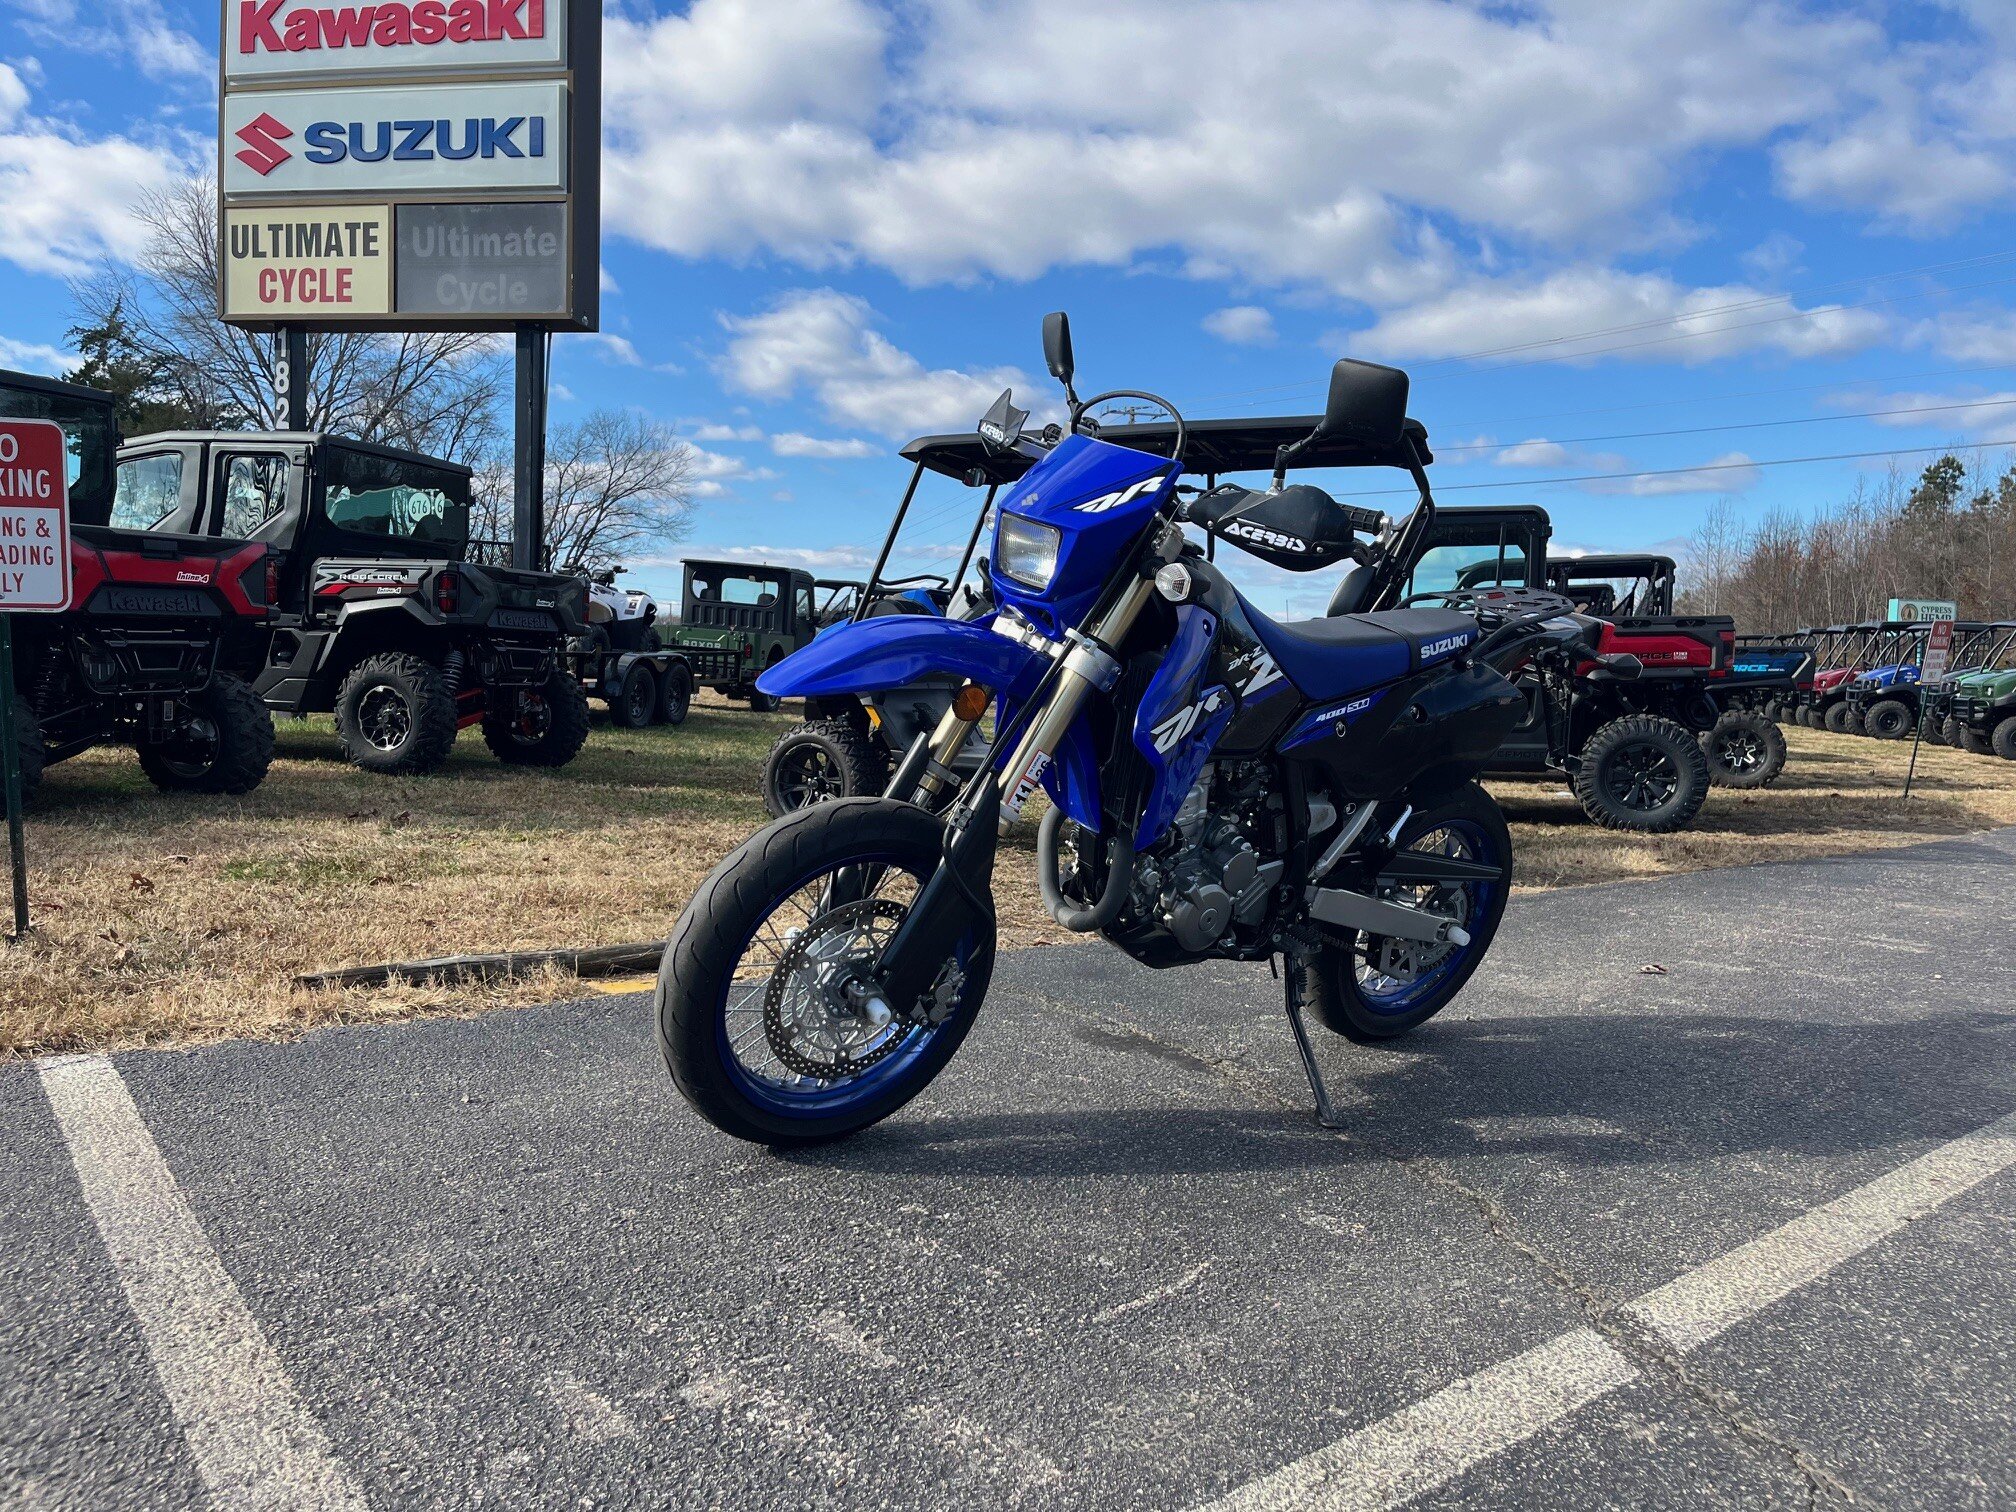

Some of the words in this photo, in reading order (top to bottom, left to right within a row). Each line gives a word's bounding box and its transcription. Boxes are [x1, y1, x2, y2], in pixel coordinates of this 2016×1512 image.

[239, 0, 545, 54] Kawasaki
[304, 116, 544, 164] SUZUKI
[231, 222, 380, 259] ULTIMATE
[412, 225, 557, 258] Ultimate
[258, 267, 354, 304] CYCLE
[436, 273, 529, 312] Cycle
[35, 517, 51, 538] &
[1224, 522, 1306, 552] ACERBIS
[108, 590, 201, 612] Kawasaki
[1921, 605, 1952, 614] CYPRESS
[497, 611, 549, 629] Kawasaki
[1420, 633, 1468, 659] SUZUKI
